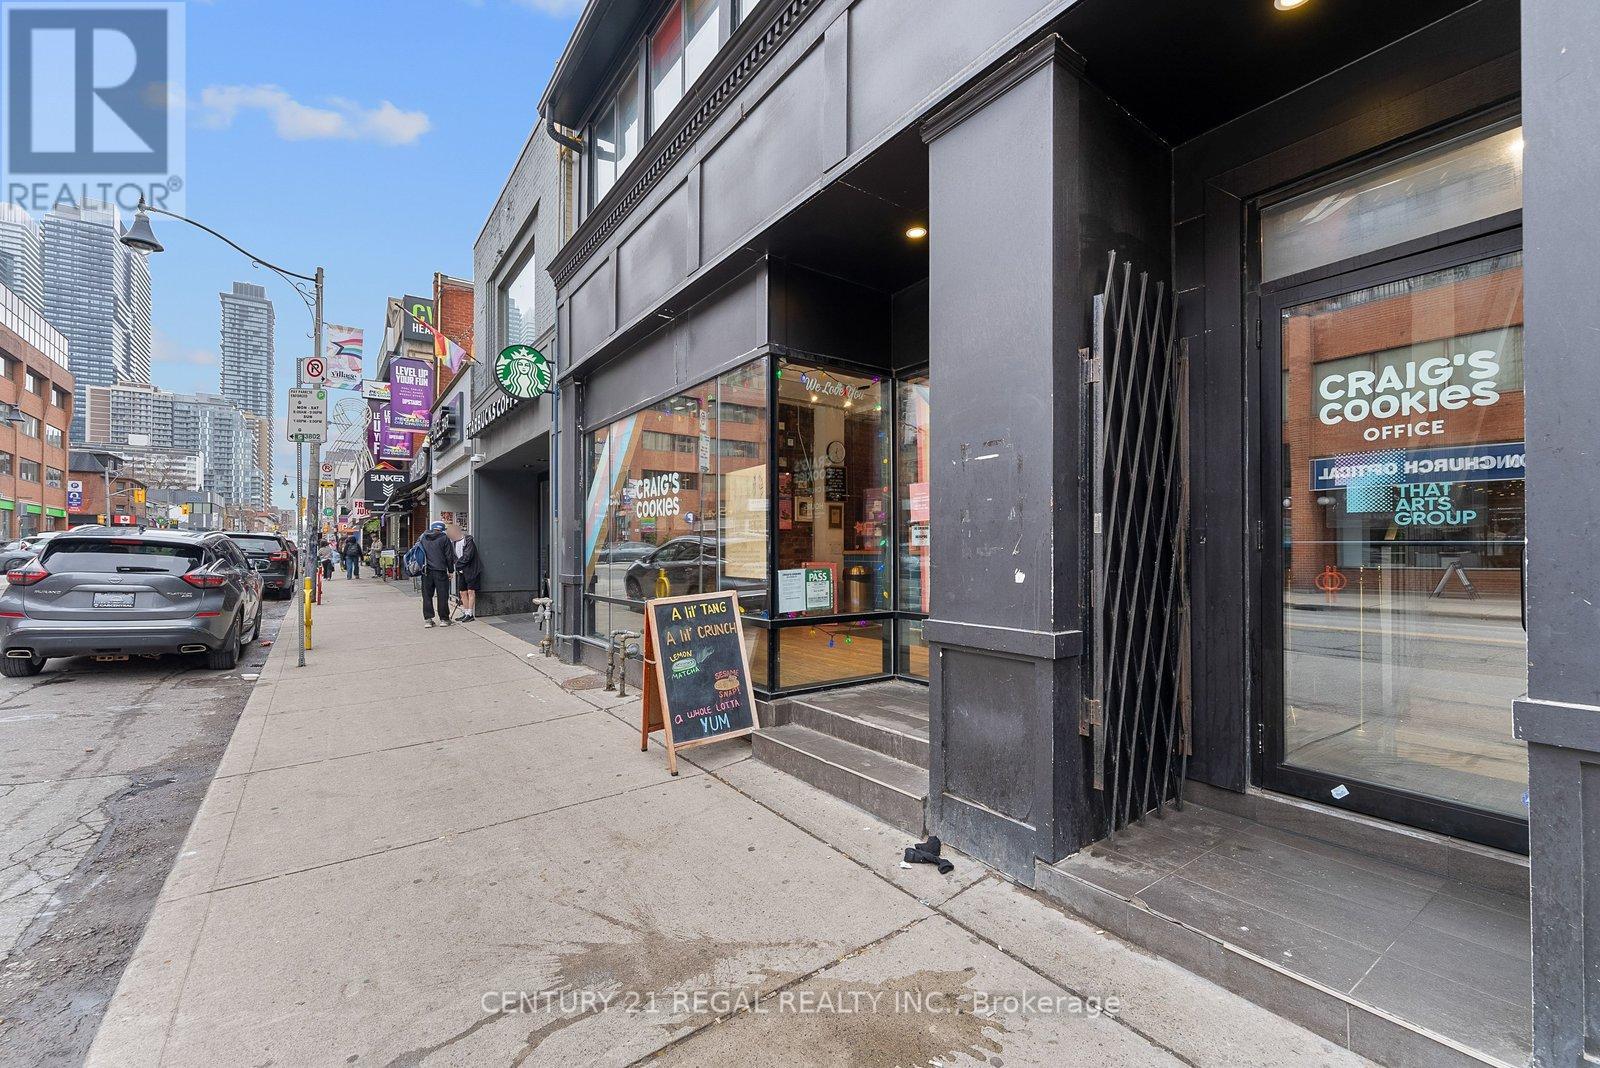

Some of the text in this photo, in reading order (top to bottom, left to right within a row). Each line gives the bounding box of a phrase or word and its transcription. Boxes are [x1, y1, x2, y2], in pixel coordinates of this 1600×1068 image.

[412, 322, 433, 335] HEA
[395, 366, 428, 378] LEVEL UP
[1319, 350, 1500, 401] CRAIG'S
[395, 375, 429, 387] YOUR FUN
[805, 378, 822, 392] We
[402, 398, 422, 406] UPSTAIRS
[1363, 420, 1445, 441] OFFICE
[370, 474, 405, 483] BUNKER
[636, 472, 681, 500] CRAIG'S
[1398, 482, 1453, 497] THAT
[1395, 497, 1452, 512] ARTS
[1394, 510, 1477, 526] GROUP
[809, 572, 828, 582] PASS
[672, 607, 682, 621] A
[700, 601, 727, 615] TANG
[666, 631, 677, 646] A
[697, 622, 738, 639] CRUNCH
[669, 650, 693, 662] LEMON
[671, 667, 701, 680] MATCHA
[716, 699, 741, 712] LOTTA
[700, 712, 731, 733] YUM
